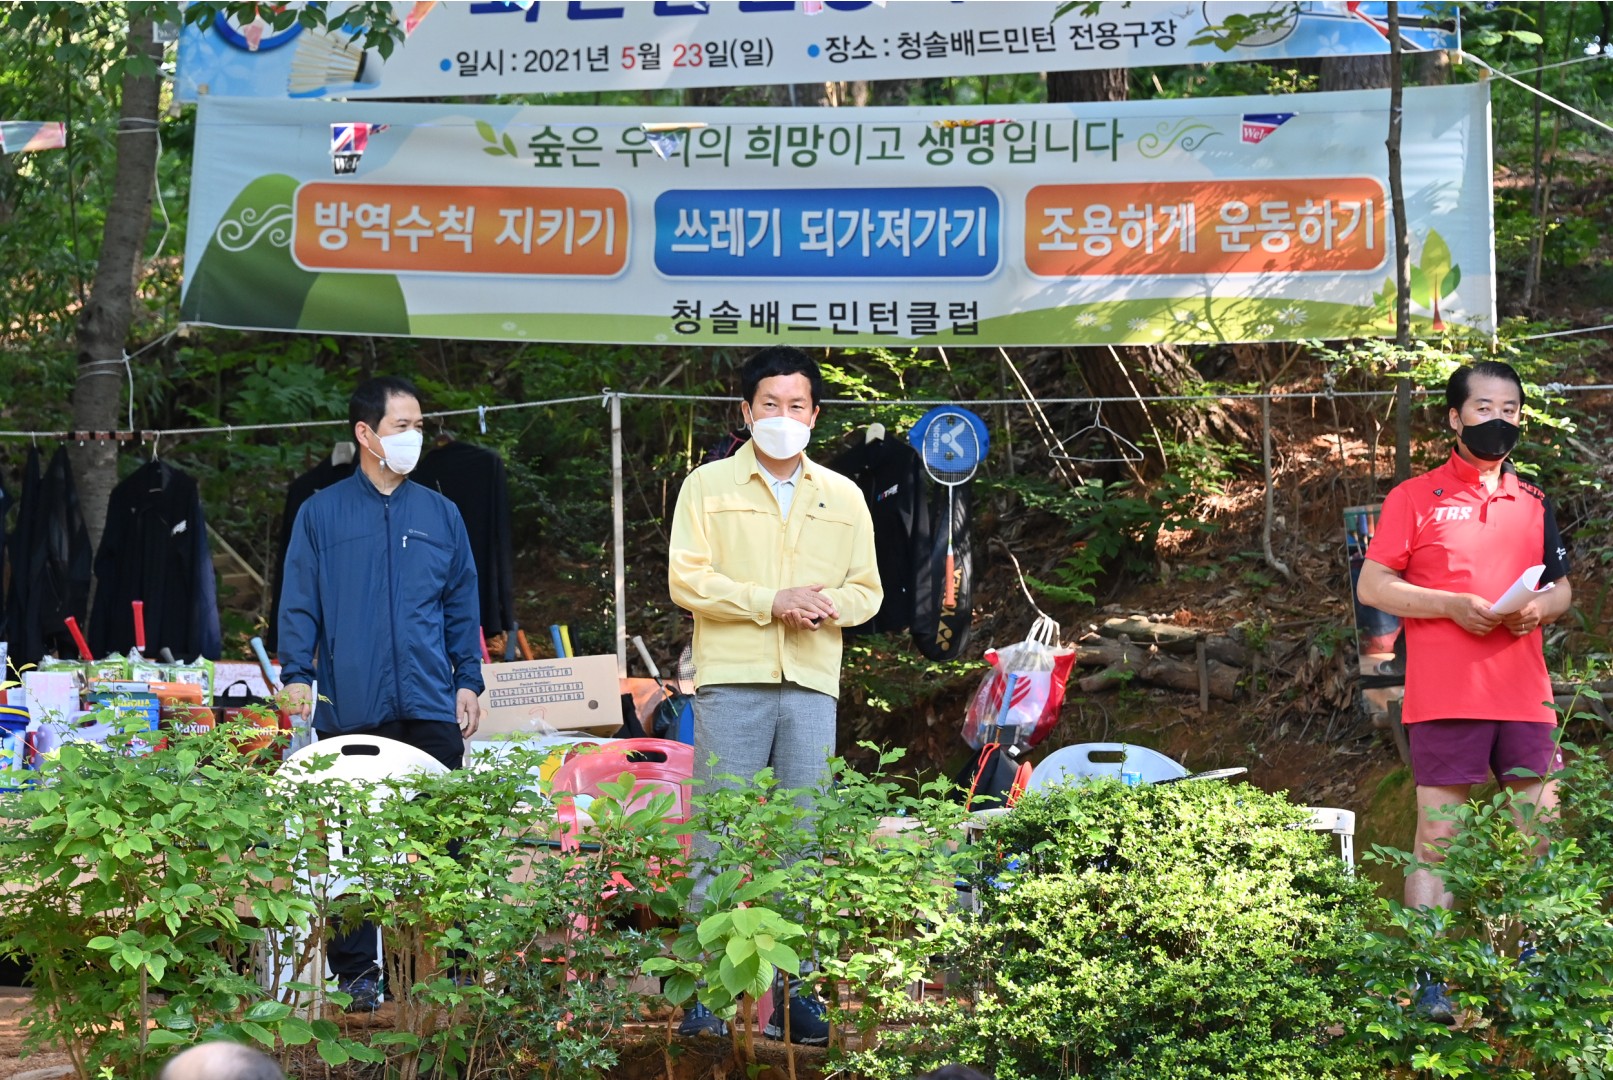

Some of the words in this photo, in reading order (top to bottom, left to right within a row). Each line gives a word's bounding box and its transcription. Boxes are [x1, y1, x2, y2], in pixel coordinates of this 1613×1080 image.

[621, 42, 661, 70] 5월
[673, 37, 774, 69] 23일(일)
[898, 24, 1056, 60] 청솔배드민턴
[1069, 19, 1177, 50] 전용구장
[528, 125, 603, 168] 숲은
[745, 124, 905, 168] 희망이고
[918, 118, 1124, 166] 생명입니다
[314, 202, 475, 254] 방역수칙
[494, 206, 615, 256] 지키기
[671, 207, 781, 257] 쓰레기
[799, 206, 987, 258] 되가져가기
[1038, 202, 1197, 256] 조용하게
[1215, 198, 1375, 254] 운동하기
[671, 299, 979, 335] 청솔배드민턴클럽
[1434, 506, 1473, 522] TRS
